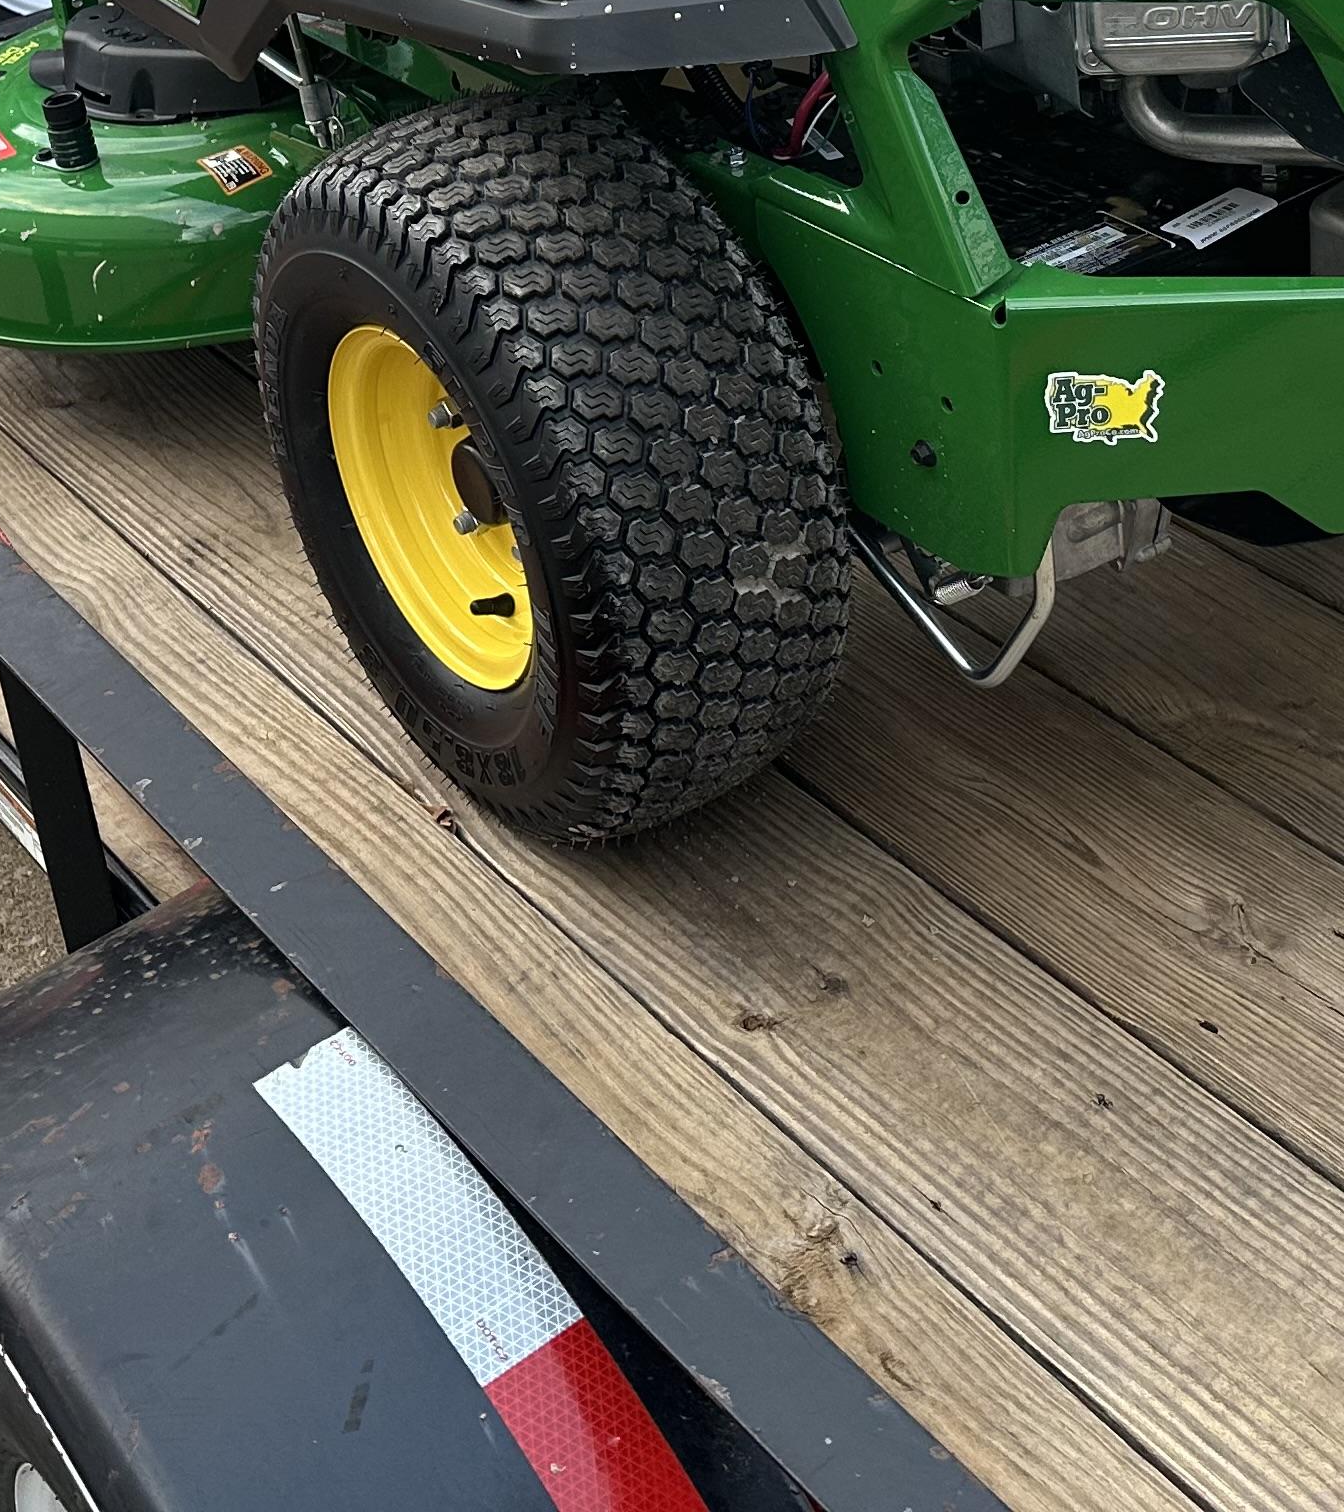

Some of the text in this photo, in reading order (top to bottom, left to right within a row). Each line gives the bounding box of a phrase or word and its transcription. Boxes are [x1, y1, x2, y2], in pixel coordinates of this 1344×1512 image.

[1143, 2, 1255, 31] OHV
[1052, 377, 1106, 407] Ag-
[1055, 403, 1110, 428] Pro
